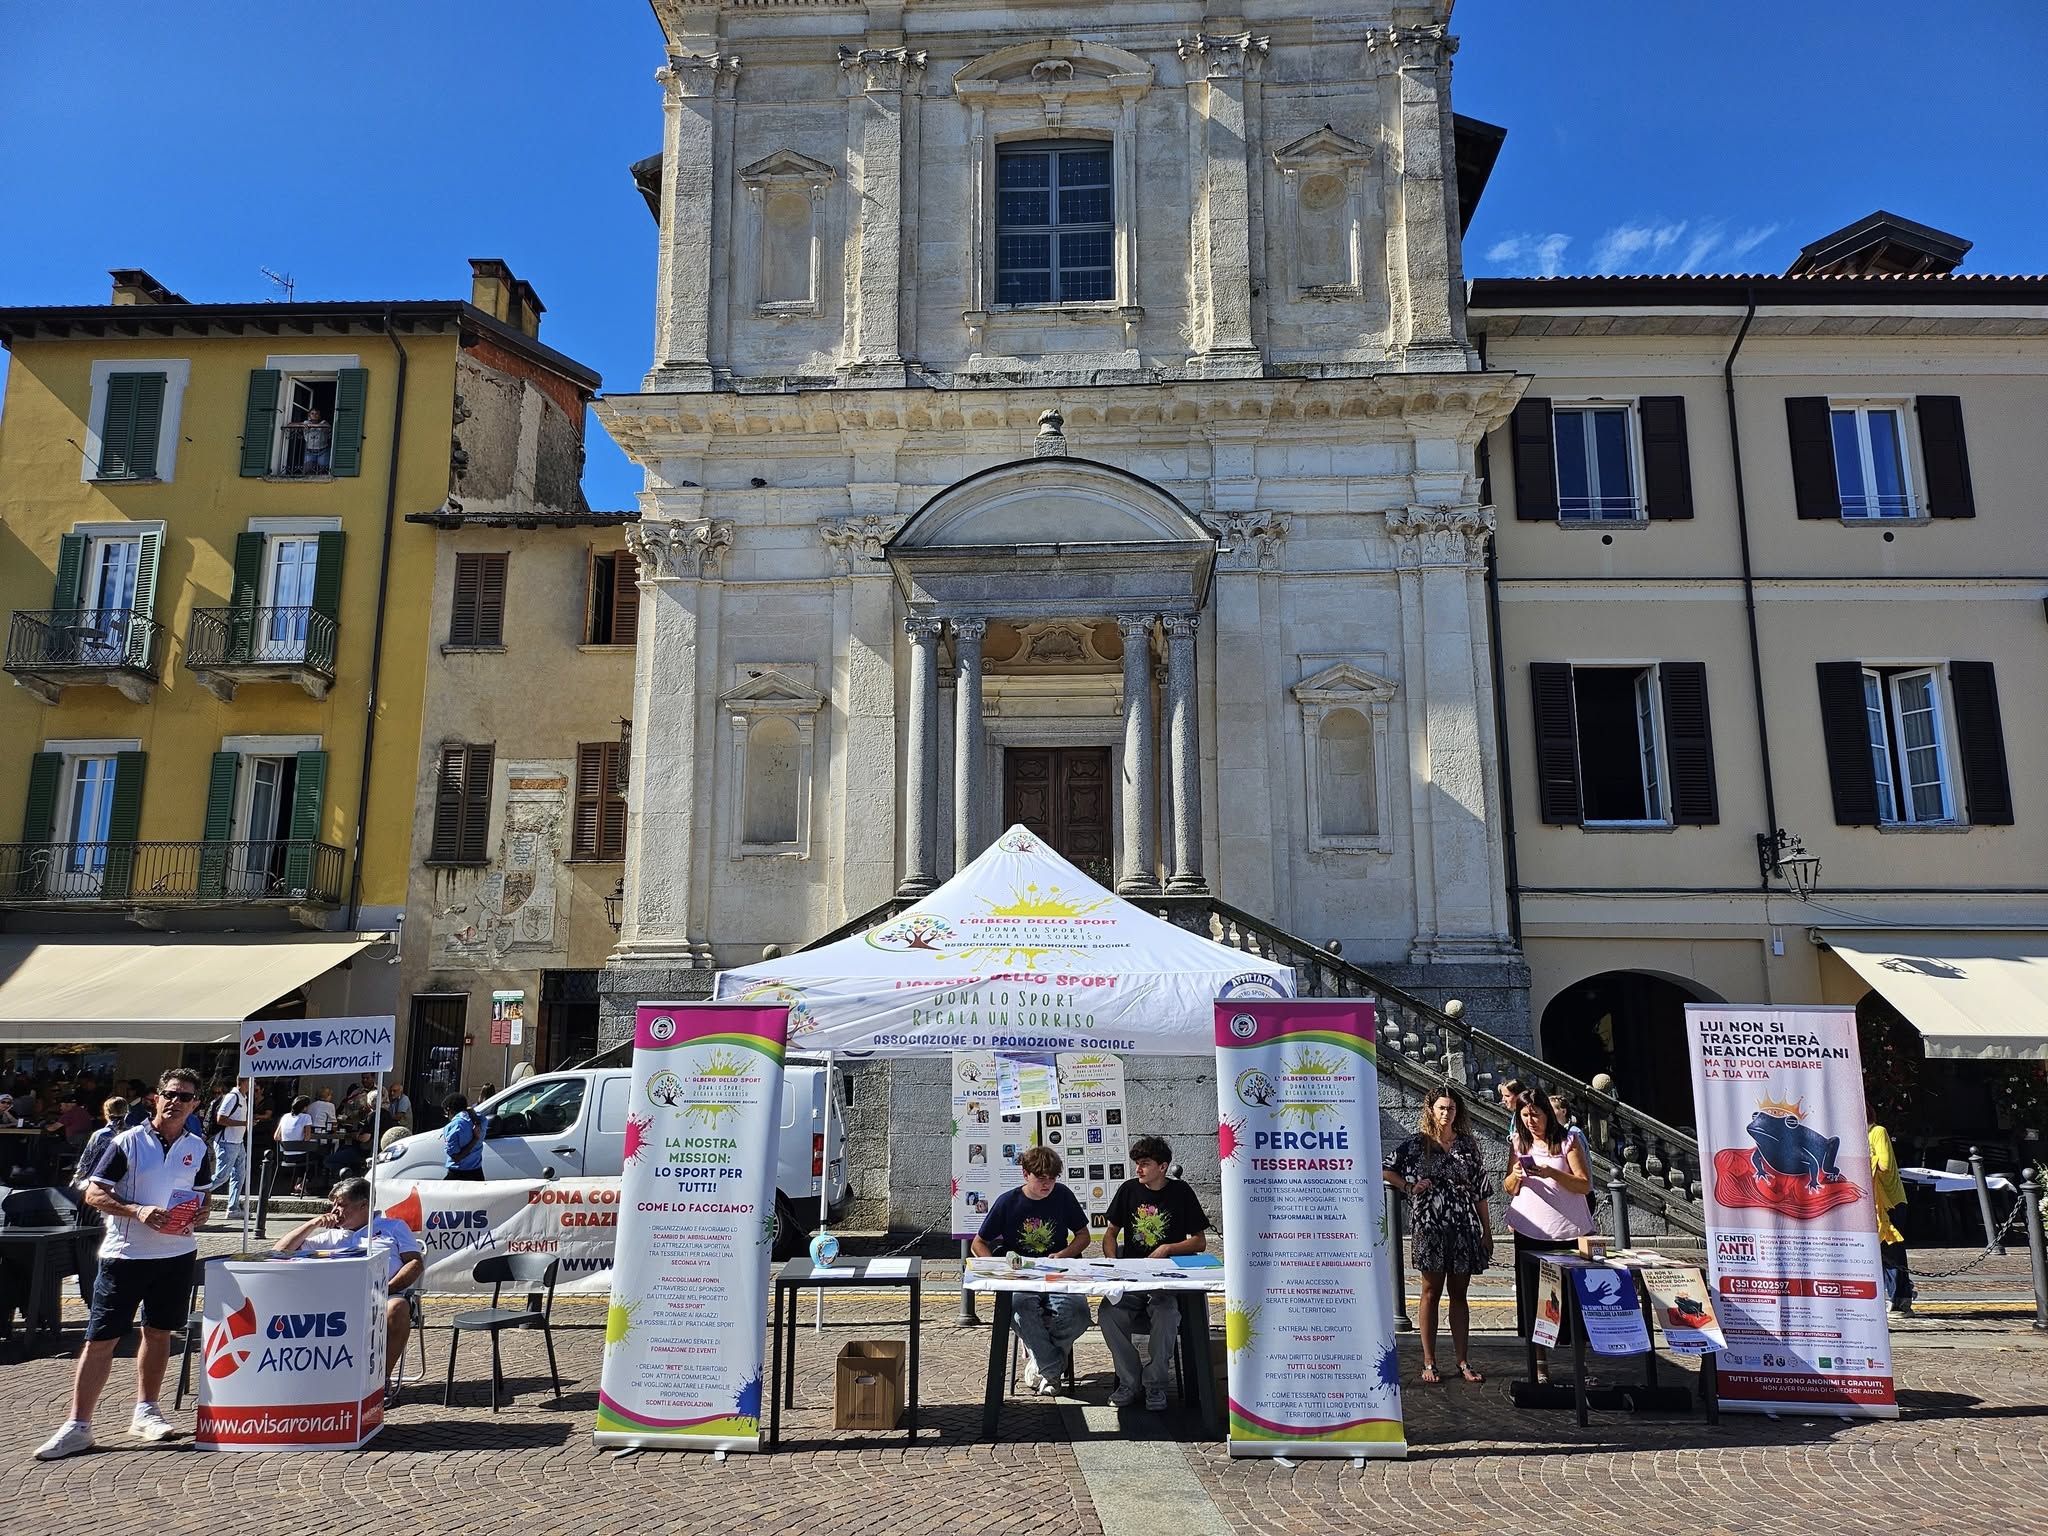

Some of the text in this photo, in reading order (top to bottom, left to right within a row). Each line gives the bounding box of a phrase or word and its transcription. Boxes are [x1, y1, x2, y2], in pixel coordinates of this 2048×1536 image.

[1056, 975, 1117, 988] SPORT
[1231, 973, 1272, 987] AFFILIATA
[934, 991, 980, 1007] DONA
[990, 991, 1009, 1006] LO
[913, 1009, 1094, 1028] REGALA UN SORRISO
[1700, 1021, 1784, 1033] LUI NON SI
[267, 1027, 391, 1049] AVIS ARONA
[874, 1034, 1136, 1050] ASSOCIAZIONE DI PROMOZIONE SOCIALE
[1701, 1032, 1820, 1046] TRASFORMERÀ
[1702, 1046, 1849, 1059] NEANCHE DOMANI
[252, 1051, 382, 1072] www.avisarona.it
[1704, 1059, 1720, 1067] MA
[1740, 1060, 1765, 1068] PUOI
[1768, 1061, 1822, 1069] CAMBIARE
[1705, 1070, 1770, 1079] LA TUA VITA
[665, 1138, 737, 1148] LA NOSTRA
[1255, 1125, 1349, 1150] PERCHÉ
[669, 1152, 731, 1163] MISSION:
[1251, 1158, 1354, 1171] TESSERARSI?
[655, 1167, 743, 1179] LO SPORT PER
[678, 1182, 717, 1193] TUTTI!
[528, 1190, 583, 1204] DONA
[637, 1202, 754, 1213] COME LO FACCIAMO?
[424, 1210, 489, 1229] AVIS
[561, 1212, 618, 1226] GRAZI
[424, 1230, 497, 1250] ARONA
[1717, 1234, 1754, 1243] CENTRO
[1718, 1242, 1754, 1255] ANTI
[1736, 1280, 1789, 1289] 351 0202597
[1818, 1286, 1838, 1294] 1522
[266, 1312, 347, 1339] AVIS
[256, 1344, 353, 1373] ARONA
[1847, 1379, 1884, 1388] GRATUITI,
[200, 1410, 353, 1434] www.avisarona.it
